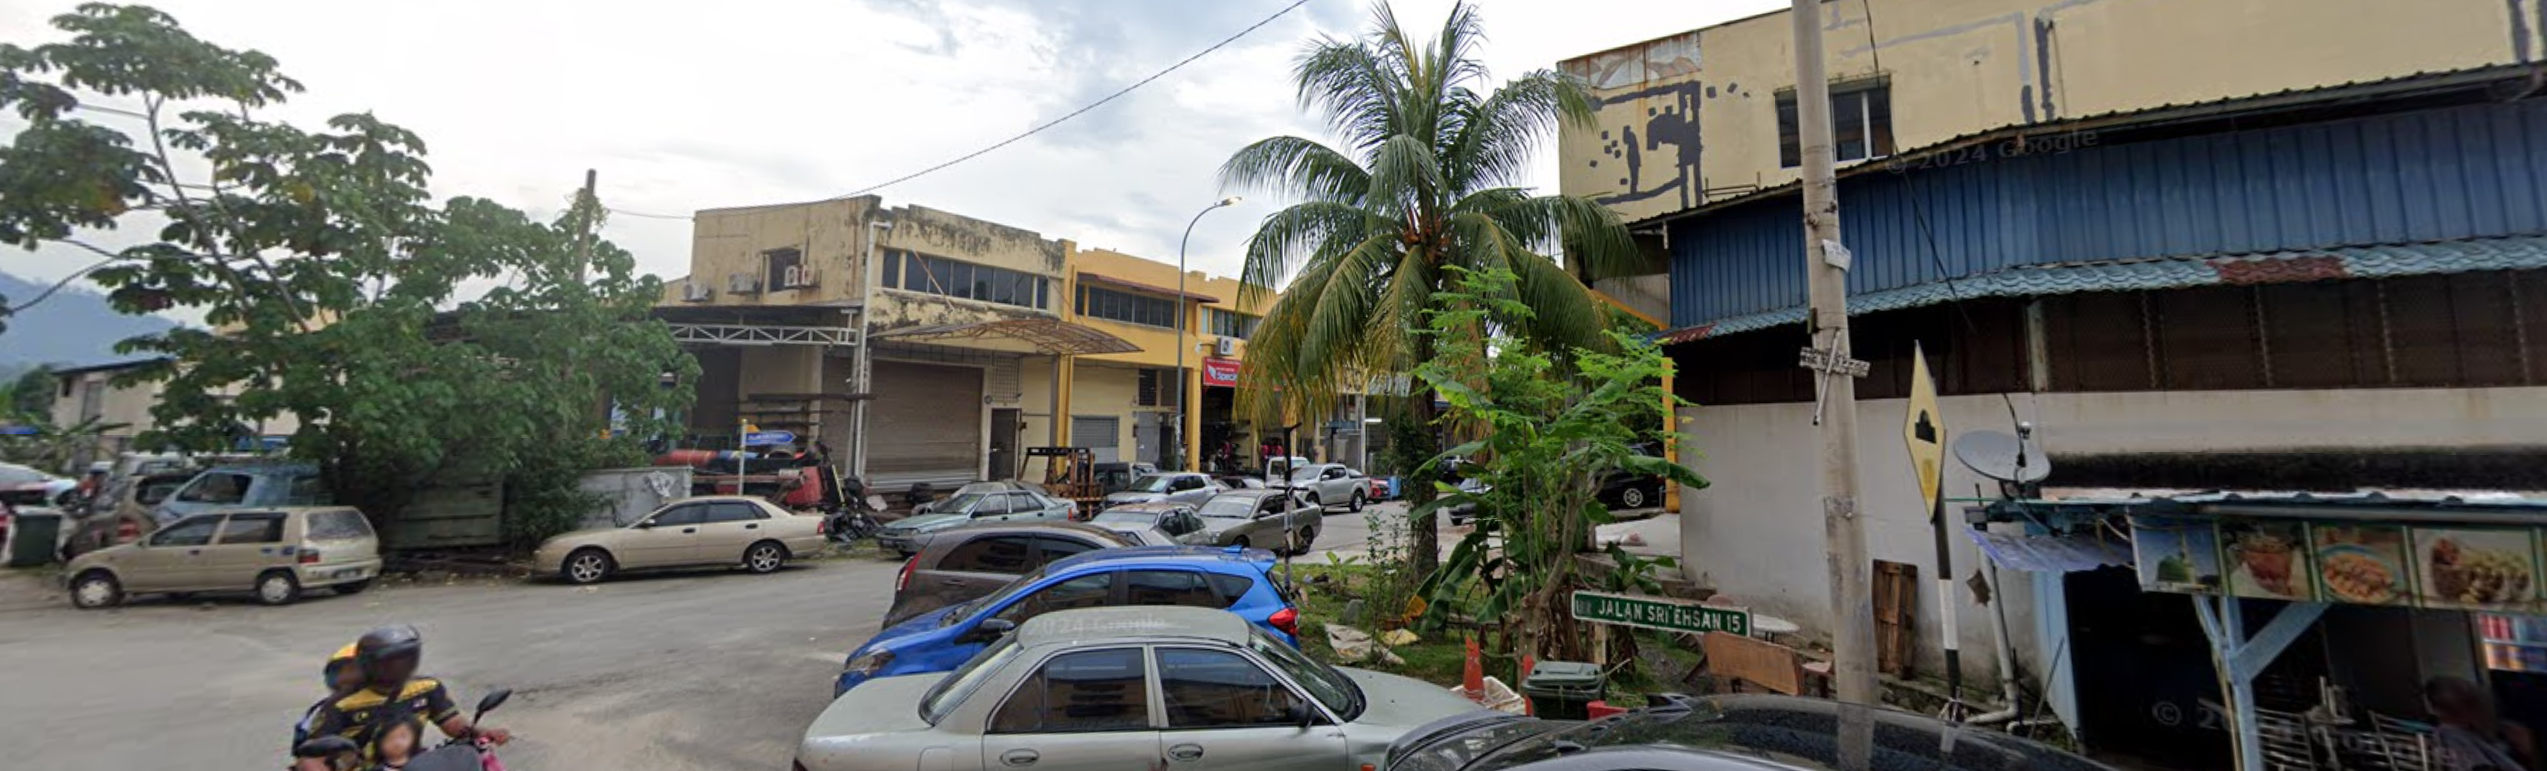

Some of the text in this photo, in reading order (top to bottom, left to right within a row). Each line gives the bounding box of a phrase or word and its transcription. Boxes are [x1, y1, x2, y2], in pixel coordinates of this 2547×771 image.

[1598, 599, 1643, 621] JALAN
[1647, 605, 1669, 624] SRI
[1673, 608, 1722, 630] EHSAN
[1727, 613, 1741, 633] 15
